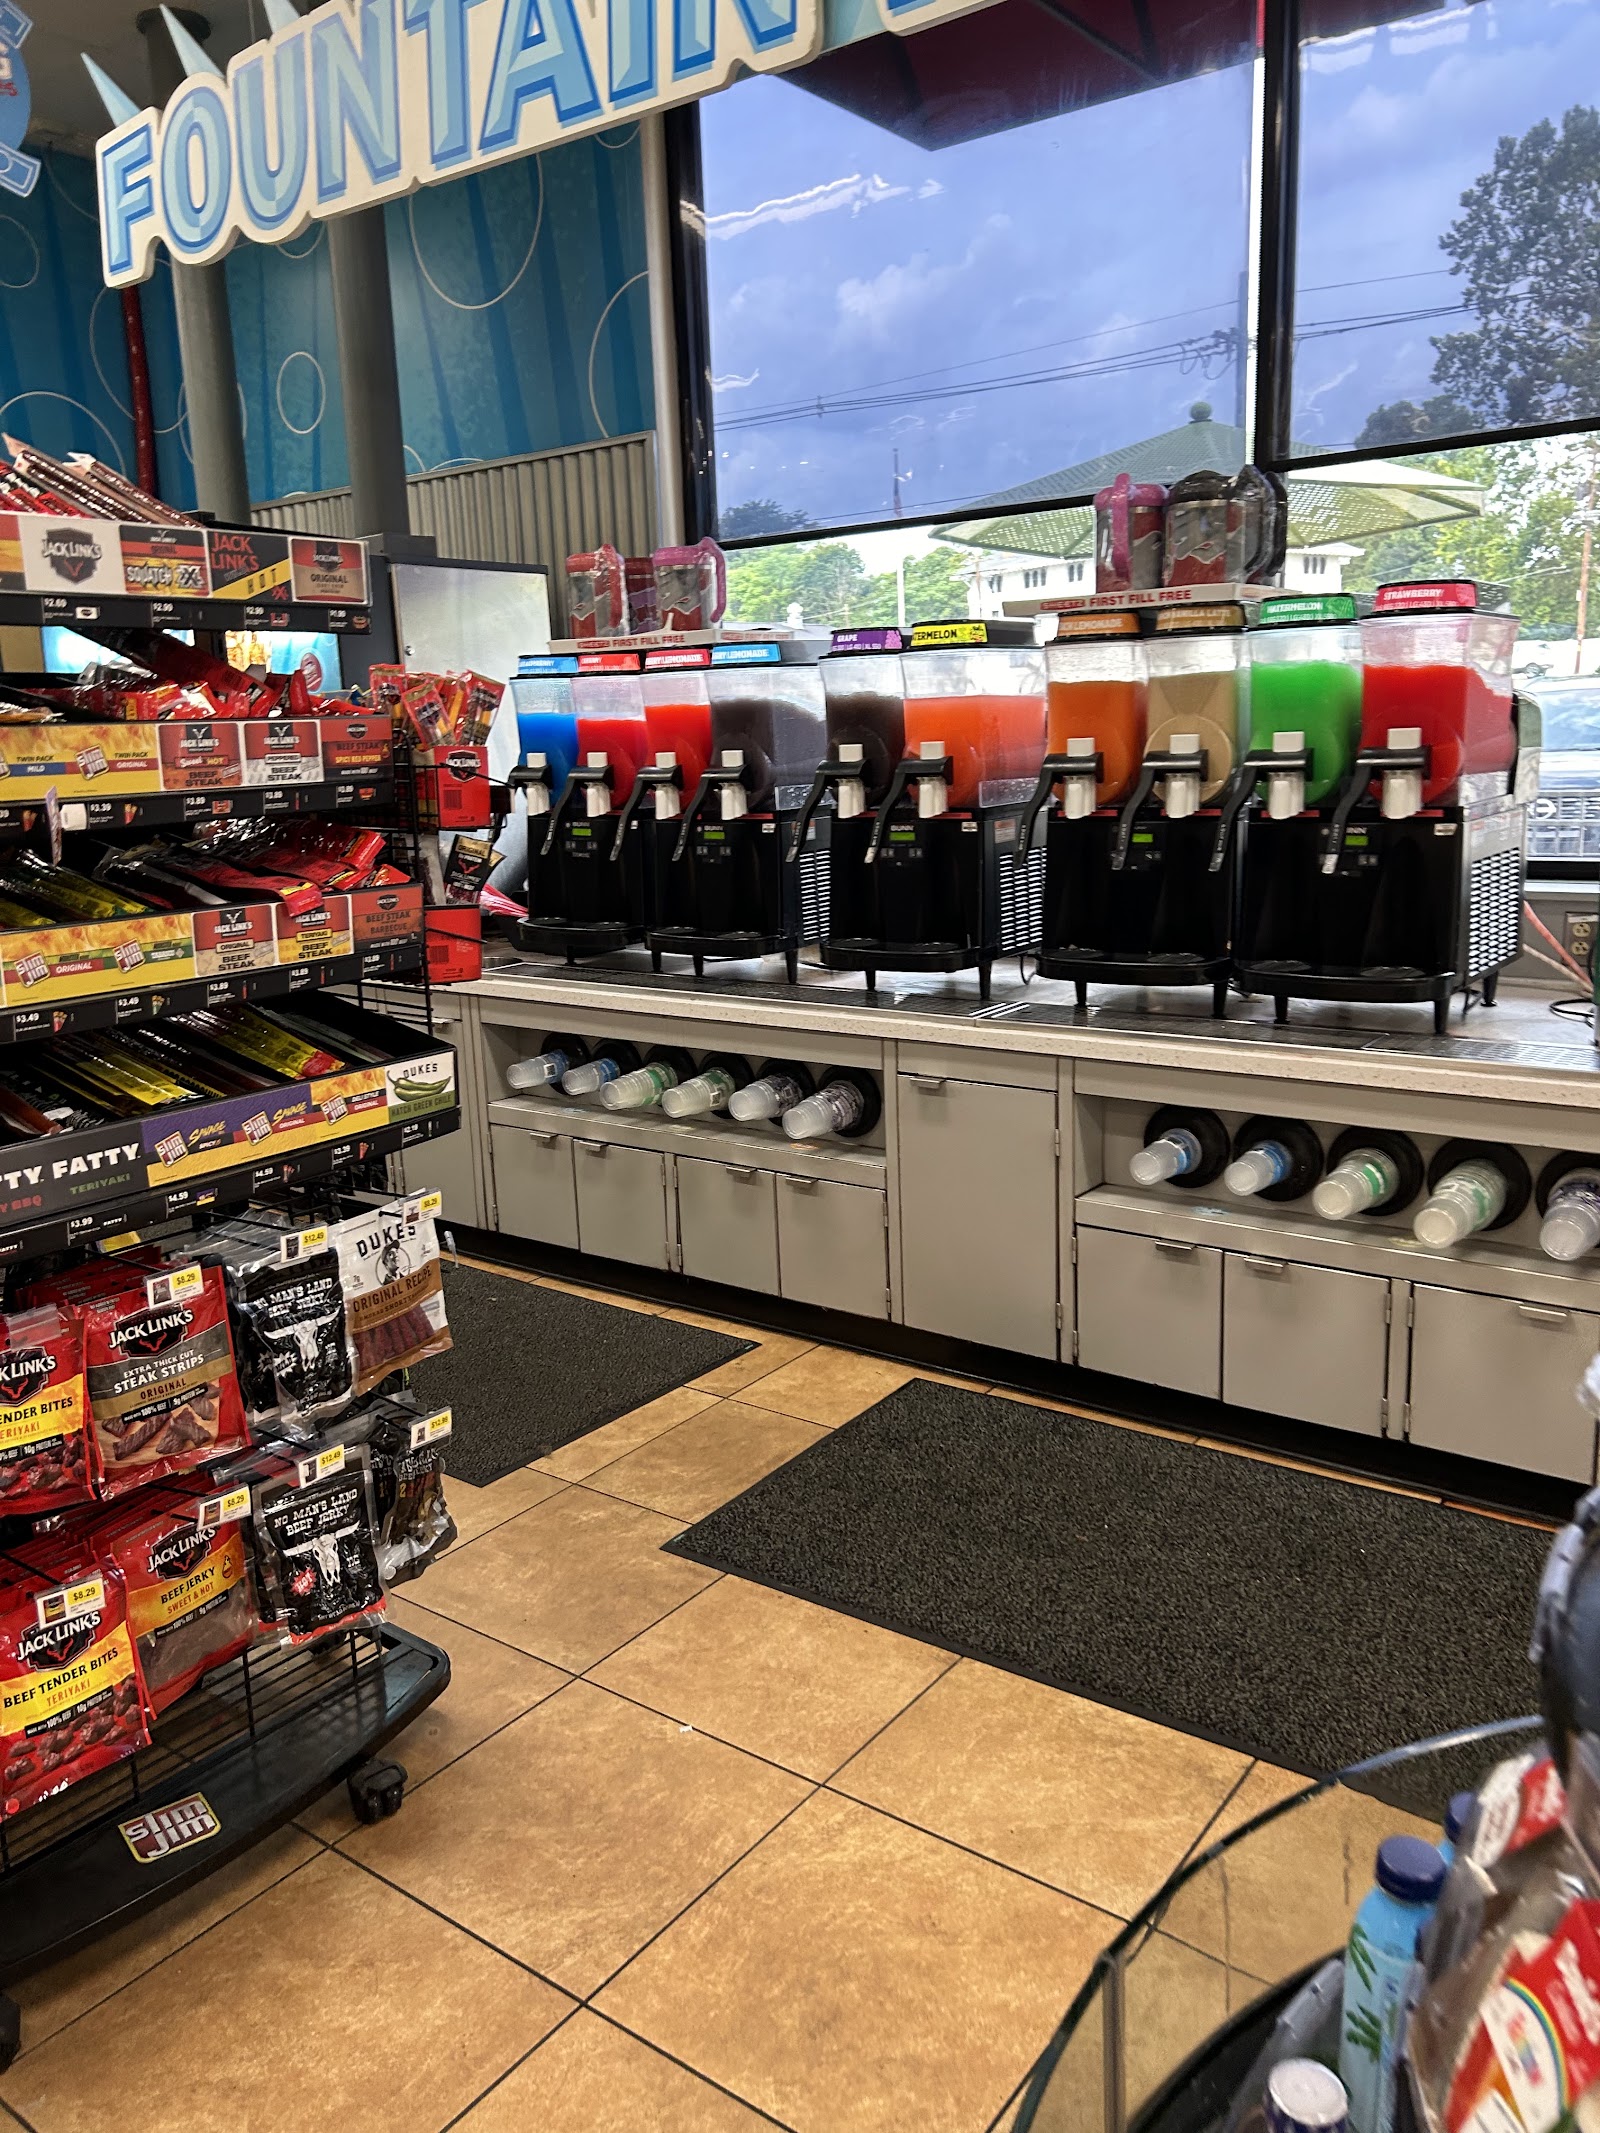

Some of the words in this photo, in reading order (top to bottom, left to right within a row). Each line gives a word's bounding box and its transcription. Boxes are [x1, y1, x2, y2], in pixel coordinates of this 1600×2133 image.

[212, 532, 253, 553] JACK
[310, 573, 348, 584] ORIGINAL
[1089, 595, 1125, 607] FIRST
[1128, 593, 1155, 604] FILL
[1159, 590, 1192, 600] FREE
[1383, 589, 1445, 600] STRAWBERRY
[640, 637, 660, 645] FILL
[662, 634, 685, 644] FREE
[836, 634, 858, 642] GRAPE
[355, 742, 381, 750] STEAK
[26, 764, 45, 773] MILD
[116, 761, 148, 769] ORIGINAL
[271, 766, 298, 774] BEEF
[189, 771, 218, 779] BEEF
[267, 773, 303, 782] STEAK
[185, 778, 222, 787] STEAK
[366, 914, 385, 922] BEEF
[386, 911, 410, 919] STEAK
[301, 930, 328, 939] TERIYAKI
[370, 923, 408, 934] BARBECUE
[220, 941, 249, 951] ORIGINAL
[302, 942, 329, 951] BEEF
[222, 953, 251, 964] BEEF
[298, 948, 333, 959] STEAK
[55, 961, 93, 974] ORIGINAL
[218, 960, 256, 972] STEAK
[16, 1012, 40, 1023] $3.49
[403, 1062, 438, 1079] DUKE'S
[413, 1100, 434, 1111] GREEN
[69, 1173, 131, 1195] TERIYAKI
[70, 1216, 93, 1228] $3.99
[303, 1231, 325, 1243] $12.49
[175, 1272, 196, 1285] $8.29
[306, 1277, 333, 1293] LAND
[353, 1284, 403, 1313] ORIGINAL
[108, 1325, 148, 1349] JACK
[147, 1309, 194, 1335] LINK'S
[10, 1355, 57, 1378] LINK'S
[123, 1363, 152, 1379] EXTRA
[153, 1356, 178, 1373] THICK
[179, 1349, 194, 1361] CUT
[113, 1371, 158, 1394] STEAK
[162, 1353, 204, 1380] STRIPS
[140, 1377, 187, 1400] ORIGINAL
[40, 1396, 73, 1414] BITES
[141, 1405, 157, 1417] 100%
[23, 1444, 35, 1455] 10g
[321, 1451, 341, 1465] $12.49
[227, 1494, 245, 1508] $8.29
[274, 1515, 289, 1529] NO
[292, 1500, 328, 1520] MAN'S
[330, 1489, 358, 1506] LAND
[285, 1517, 314, 1536] BEEF
[317, 1503, 350, 1524] JERKY
[147, 1546, 181, 1573] JACK
[160, 1584, 185, 1604] BEEF
[185, 1566, 216, 1592] JERKY
[73, 1586, 96, 1601] $8.29
[167, 1596, 192, 1614] SWEET
[193, 1590, 199, 1600] &
[200, 1581, 215, 1597] HOT
[17, 1632, 55, 1661] JACK
[54, 1610, 101, 1641] LINK'S
[3, 1688, 37, 1709] BEEF
[38, 1664, 88, 1695] TENDER
[90, 1647, 119, 1671] BITES
[46, 1679, 91, 1707] TERIYAKI
[46, 1716, 63, 1729] 100%
[76, 1702, 87, 1714] 10g
